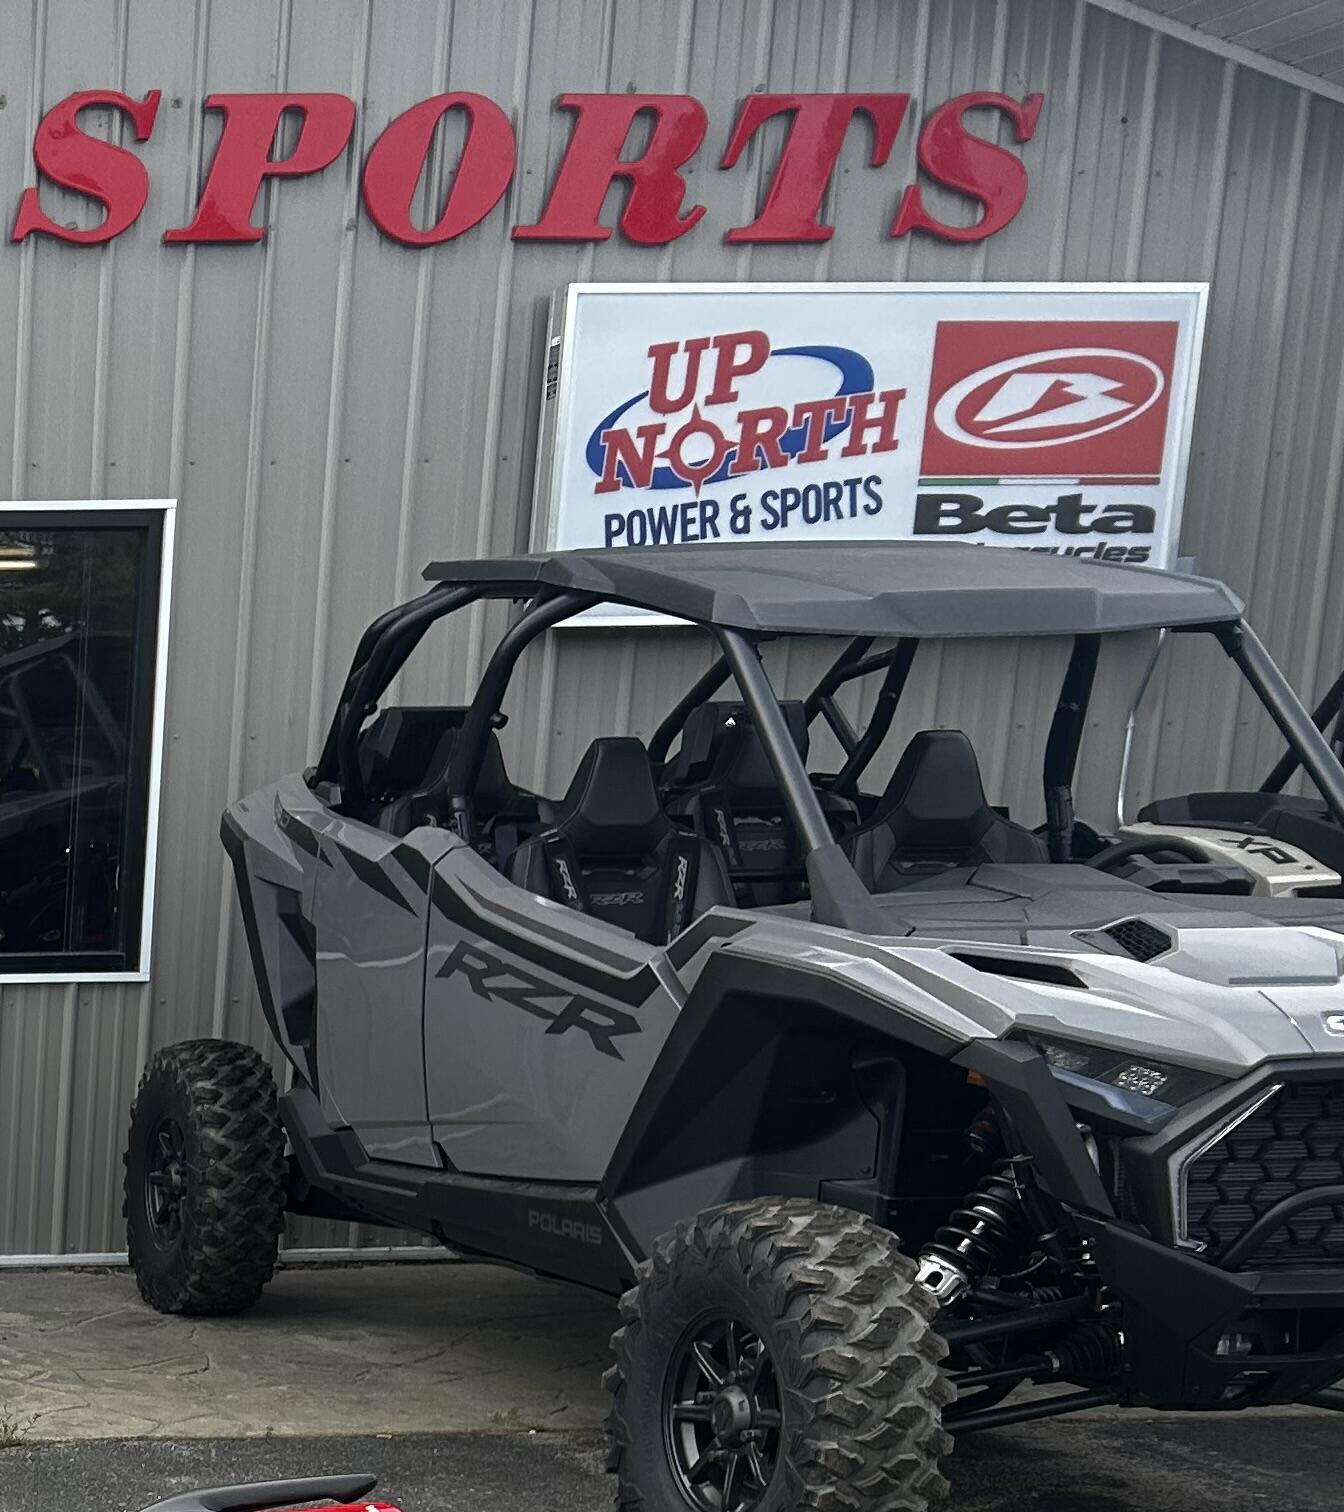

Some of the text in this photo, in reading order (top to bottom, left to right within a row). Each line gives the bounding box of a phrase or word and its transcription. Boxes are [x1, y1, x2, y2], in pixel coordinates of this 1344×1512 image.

[12, 88, 1046, 248] SPORTS
[648, 330, 770, 415] UP
[594, 388, 907, 497] NORTH
[604, 474, 883, 549] POWER & SPORTS
[913, 493, 1156, 535] Beta
[435, 940, 642, 1061] RZR
[528, 1208, 604, 1246] POLARIS
